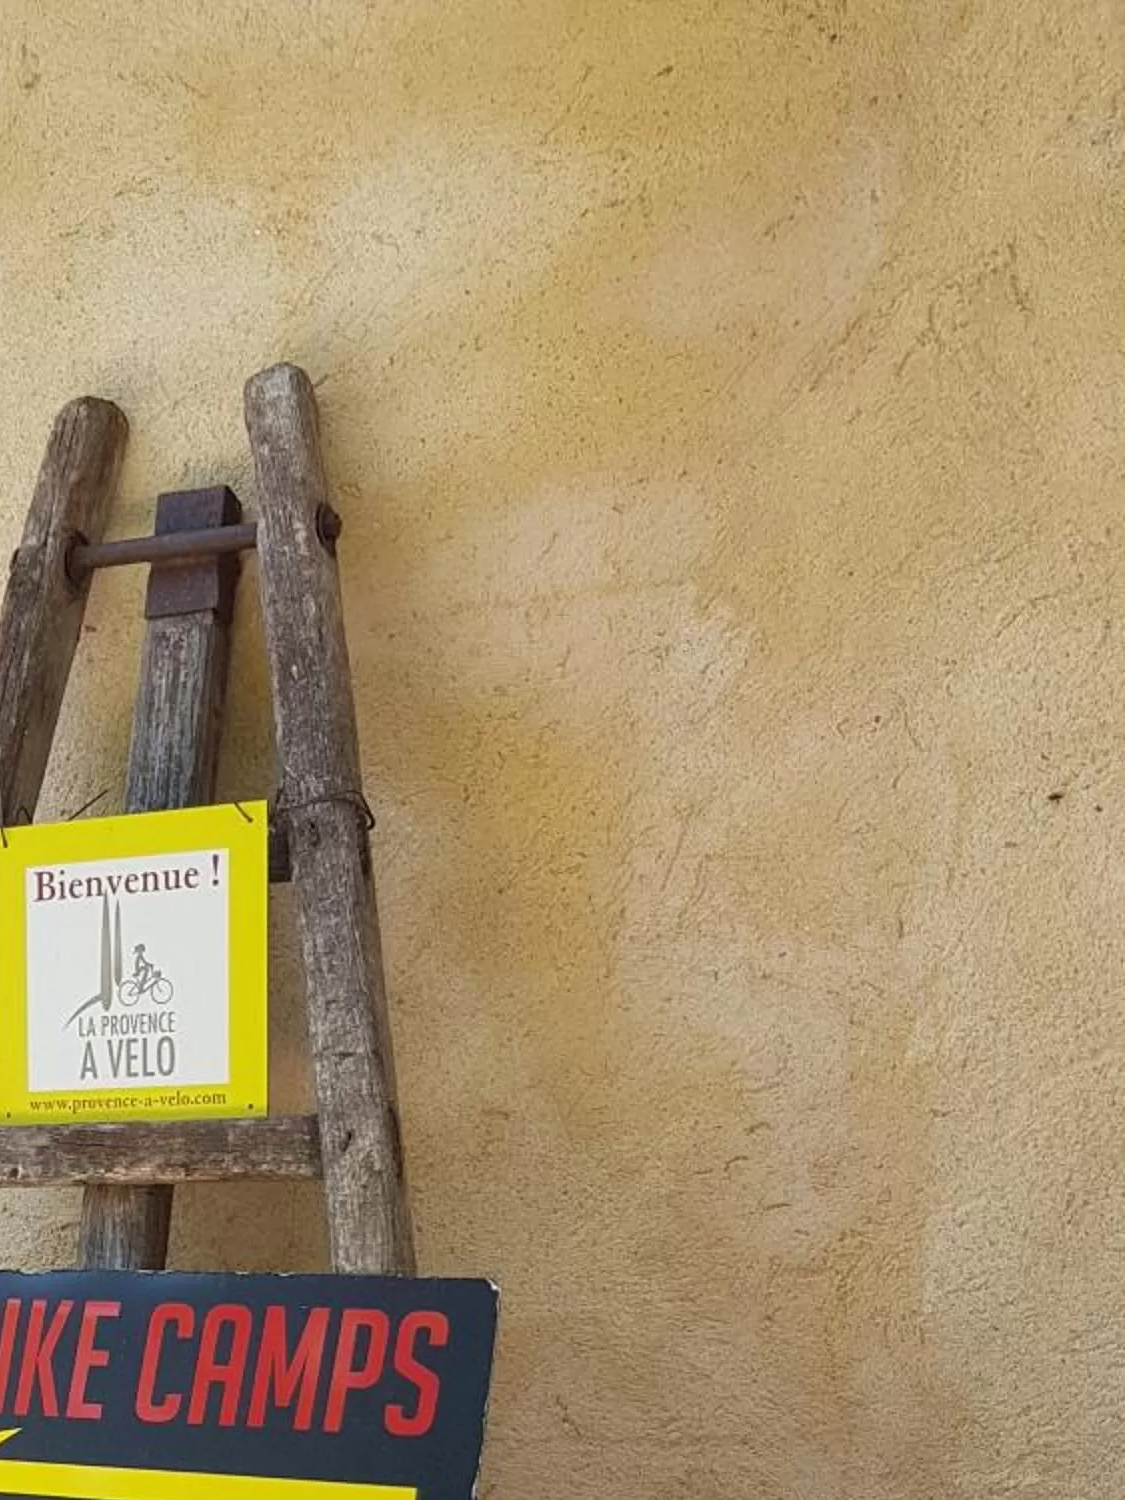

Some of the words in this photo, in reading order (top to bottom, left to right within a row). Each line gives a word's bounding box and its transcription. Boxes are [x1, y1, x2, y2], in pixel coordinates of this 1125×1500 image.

[33, 865, 200, 903] Bienvenue
[79, 1016, 95, 1037] LA
[101, 1011, 176, 1036] PROVENCE
[80, 1041, 98, 1080] A
[107, 1036, 175, 1078] VELO
[29, 1090, 227, 1115] www.provence-a-velo.com
[136, 1302, 449, 1437] CAMPS
